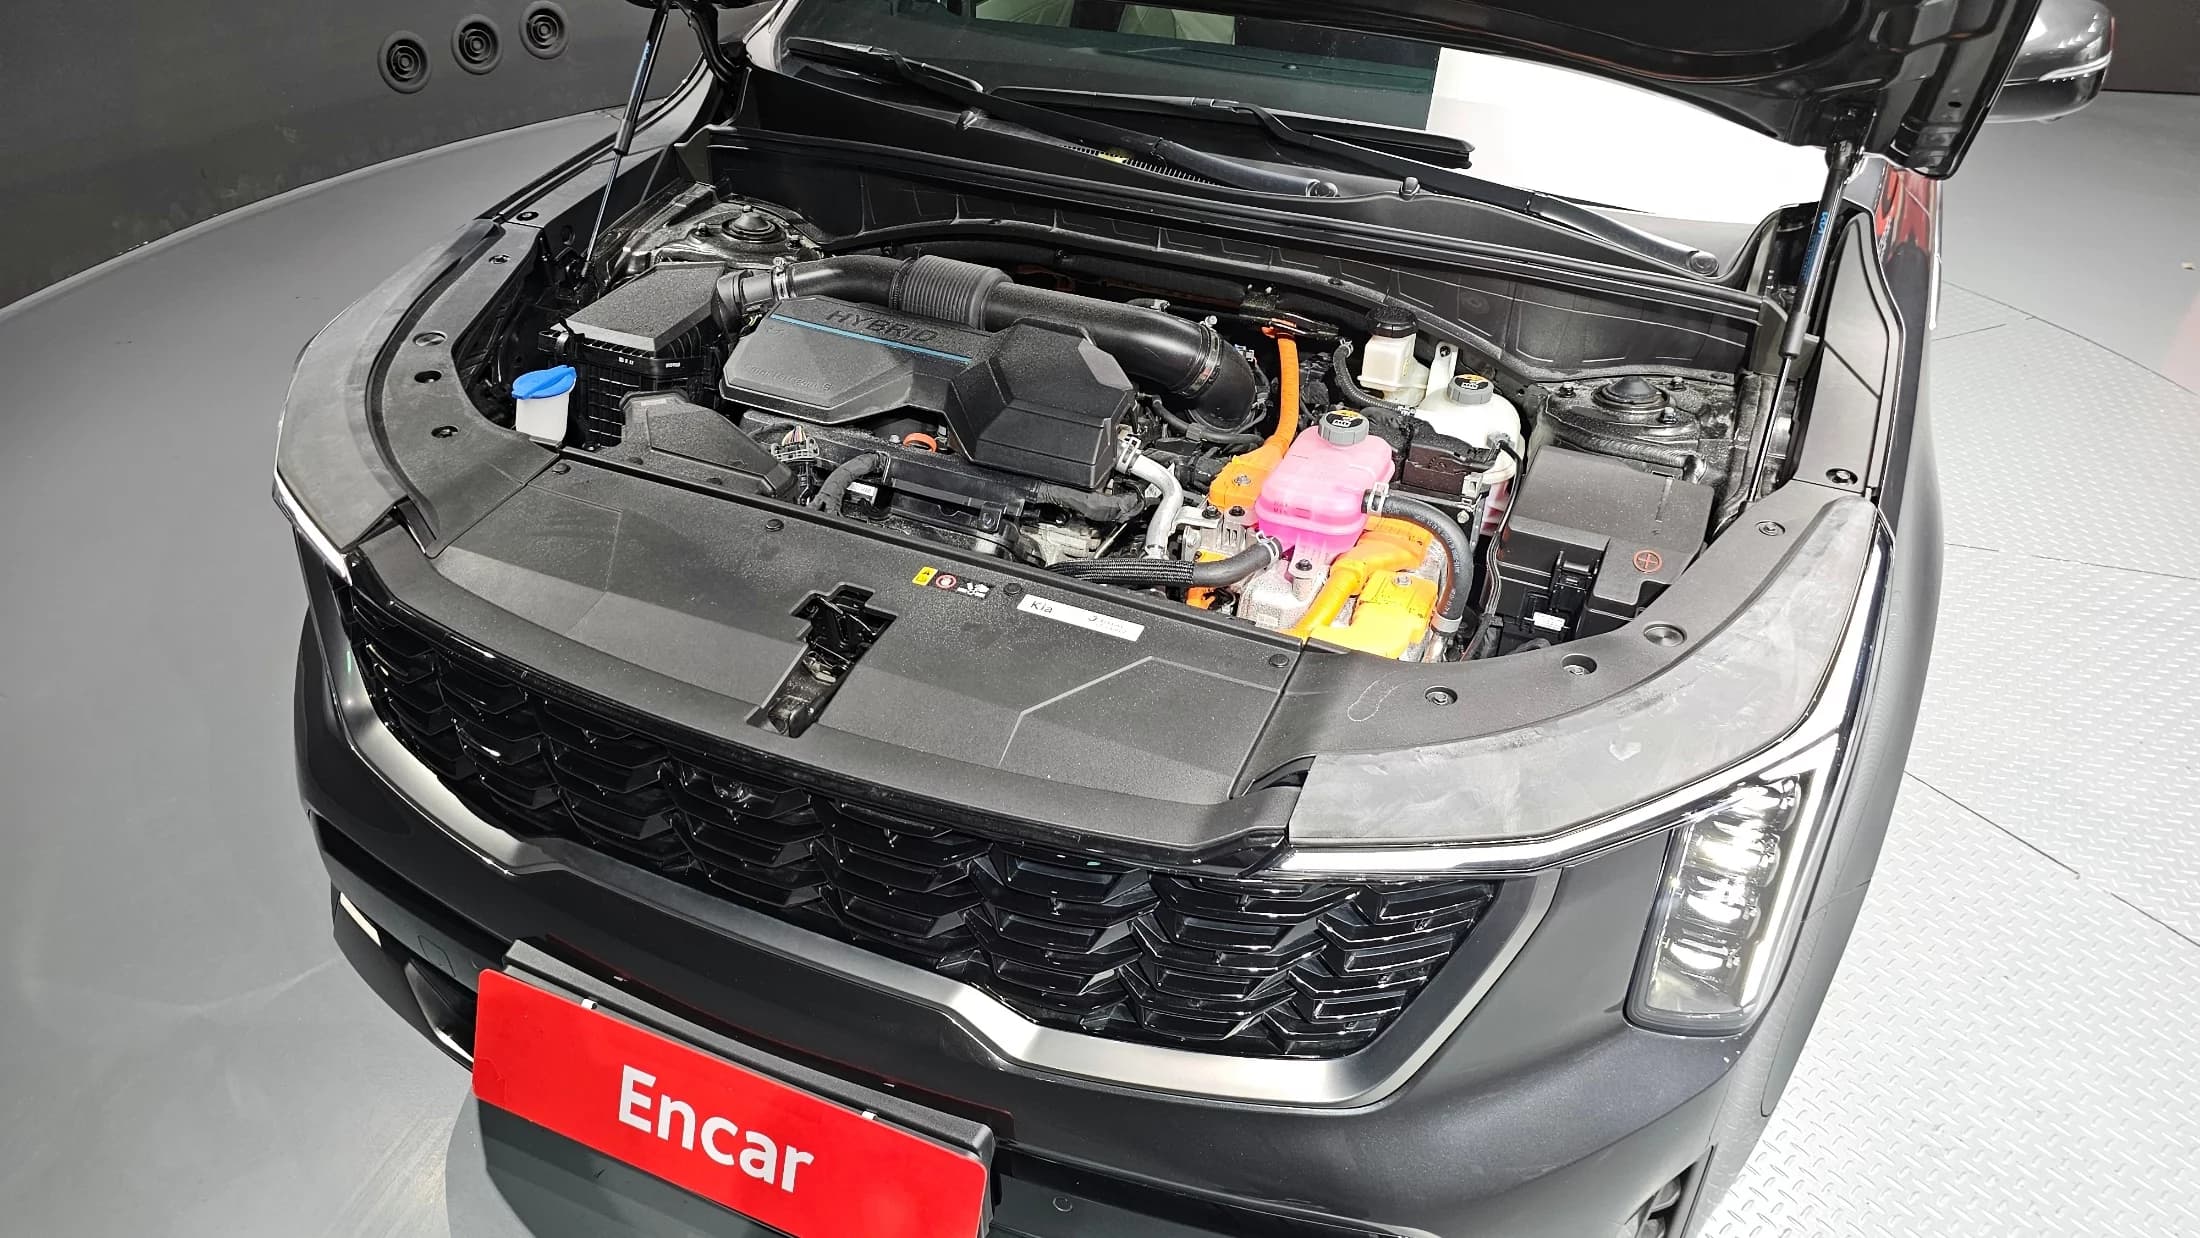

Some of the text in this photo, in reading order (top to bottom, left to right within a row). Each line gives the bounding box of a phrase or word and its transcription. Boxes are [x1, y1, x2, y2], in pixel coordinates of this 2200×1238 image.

[826, 309, 939, 342] HYBRID
[1030, 600, 1053, 614] Kia
[618, 1064, 815, 1193] Encar
